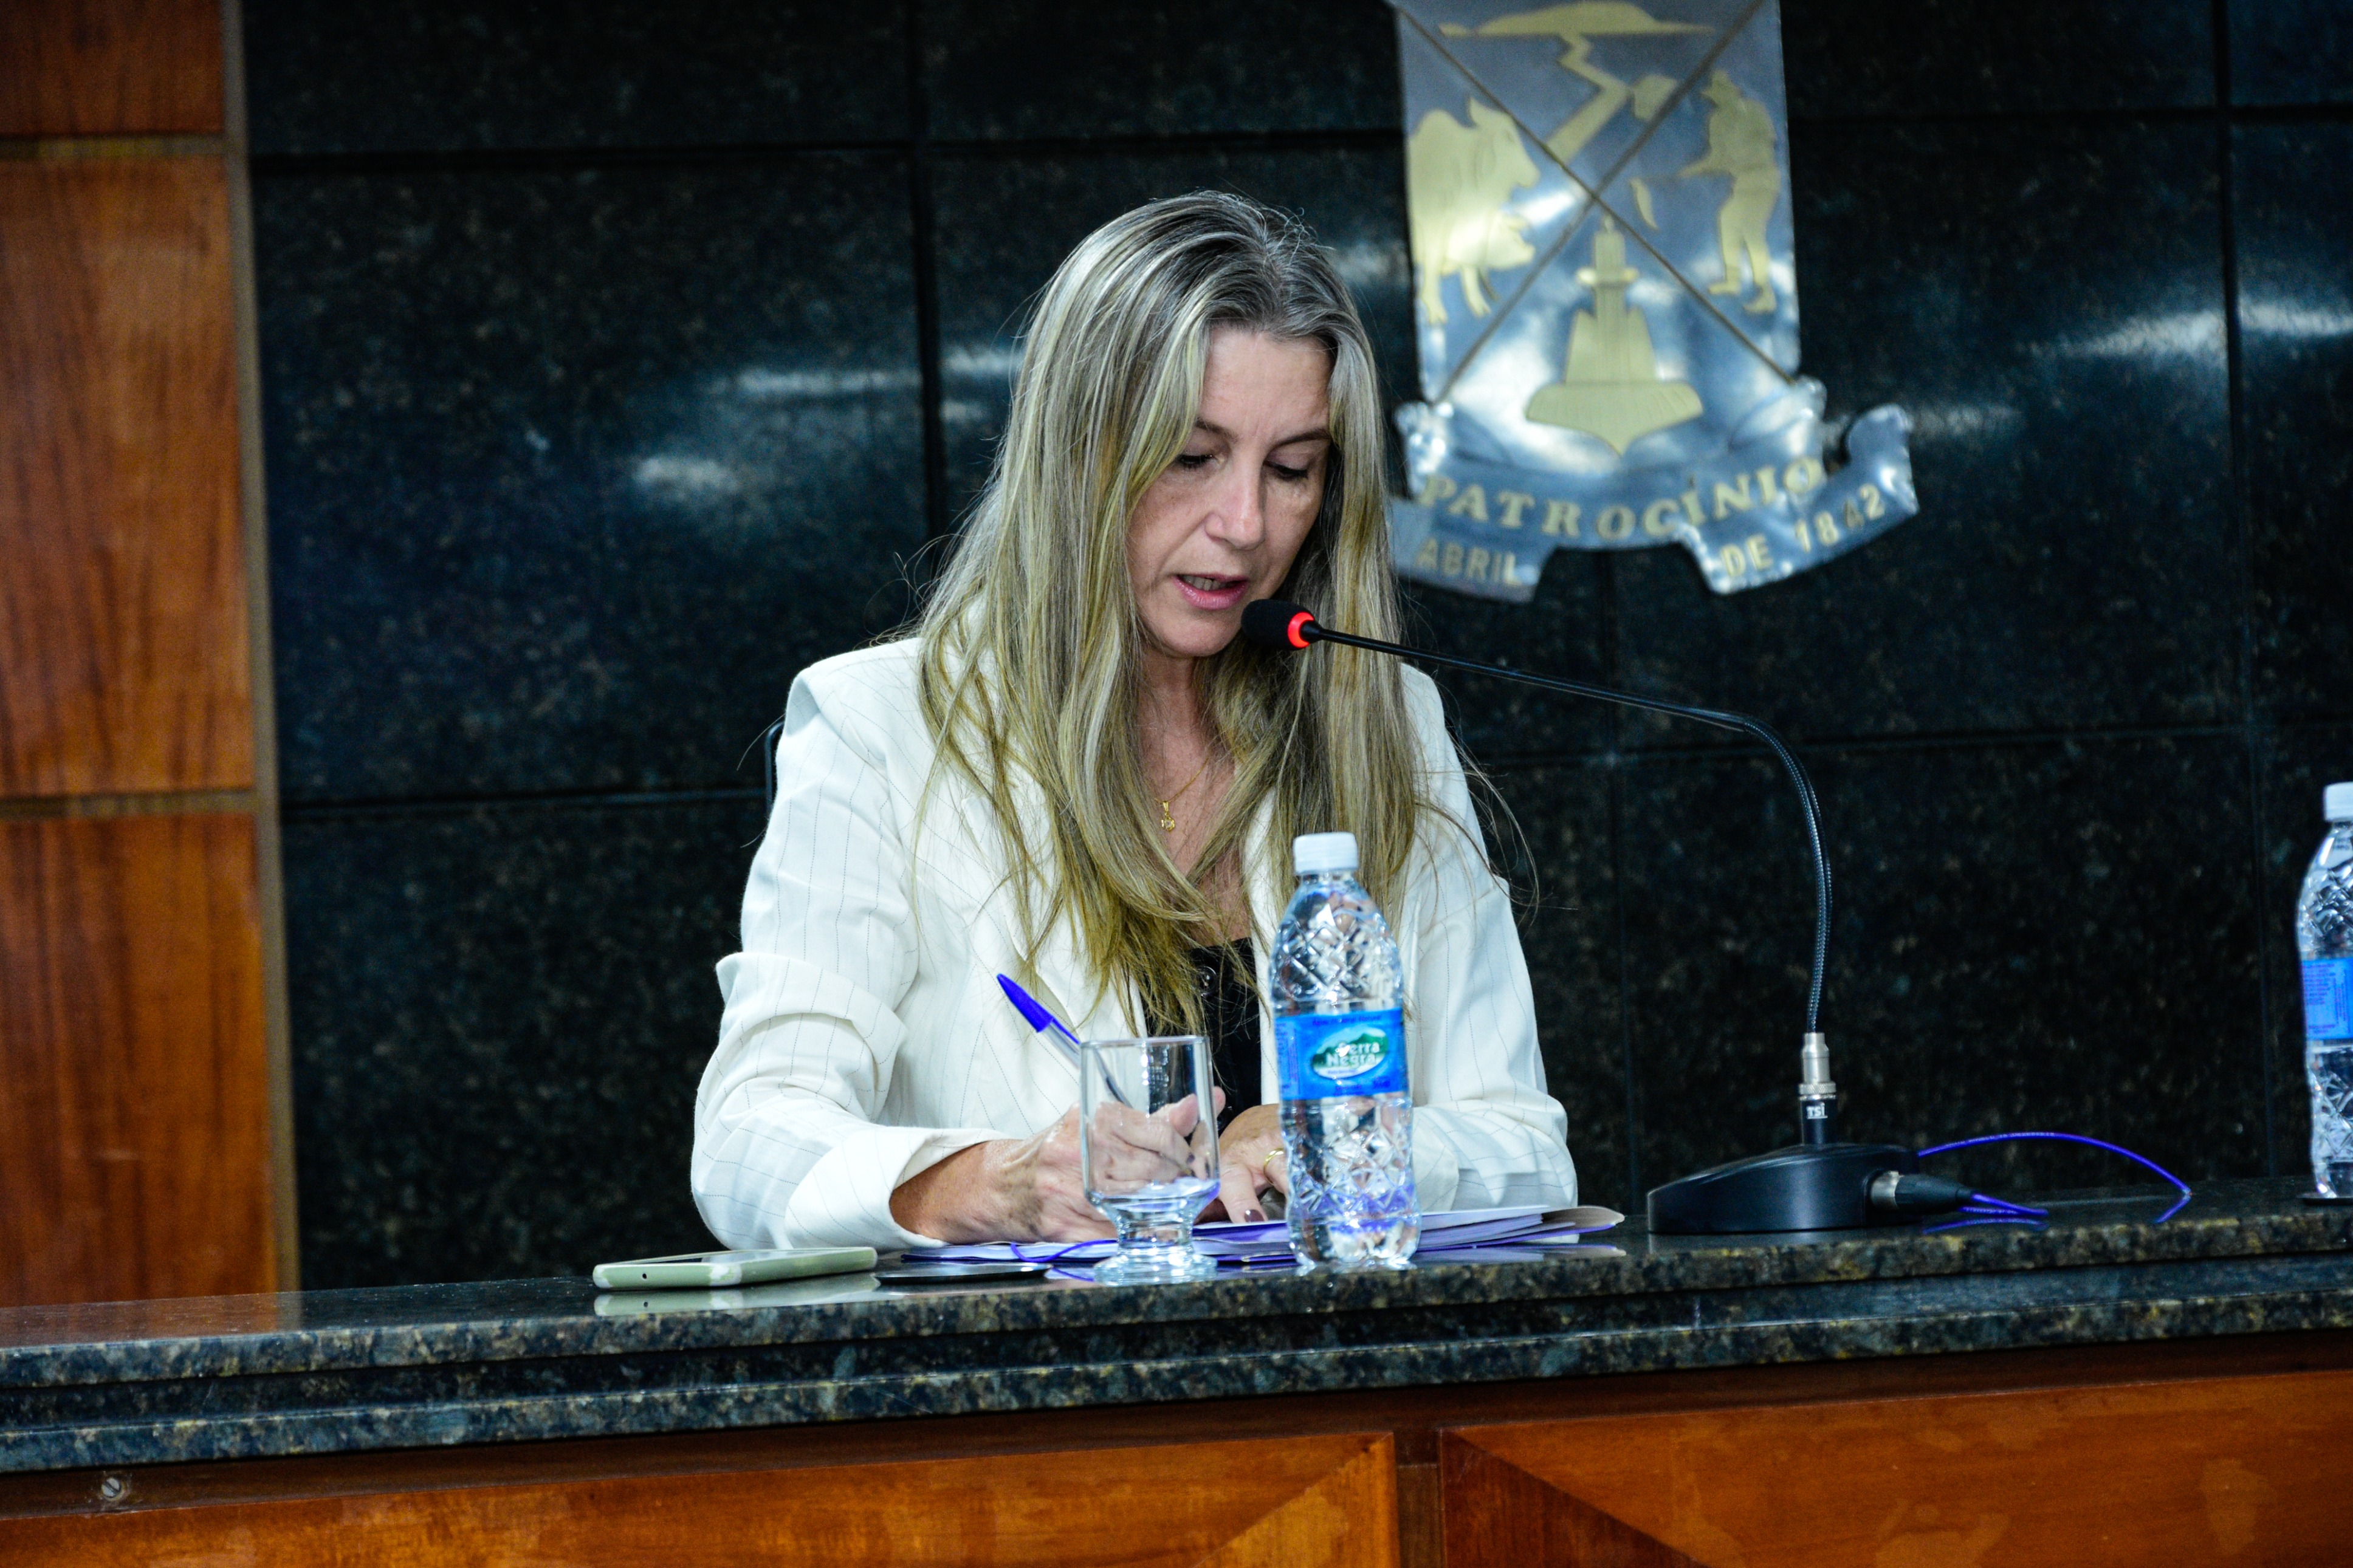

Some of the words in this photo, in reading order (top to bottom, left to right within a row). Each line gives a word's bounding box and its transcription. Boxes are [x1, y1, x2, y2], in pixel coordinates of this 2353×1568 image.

[1416, 537, 1522, 586] ABRIL
[1720, 534, 1773, 577] DE
[1795, 483, 1885, 553] 1842
[1417, 456, 1824, 541] PATROCÍNIO
[1326, 1052, 1376, 1069] Negra
